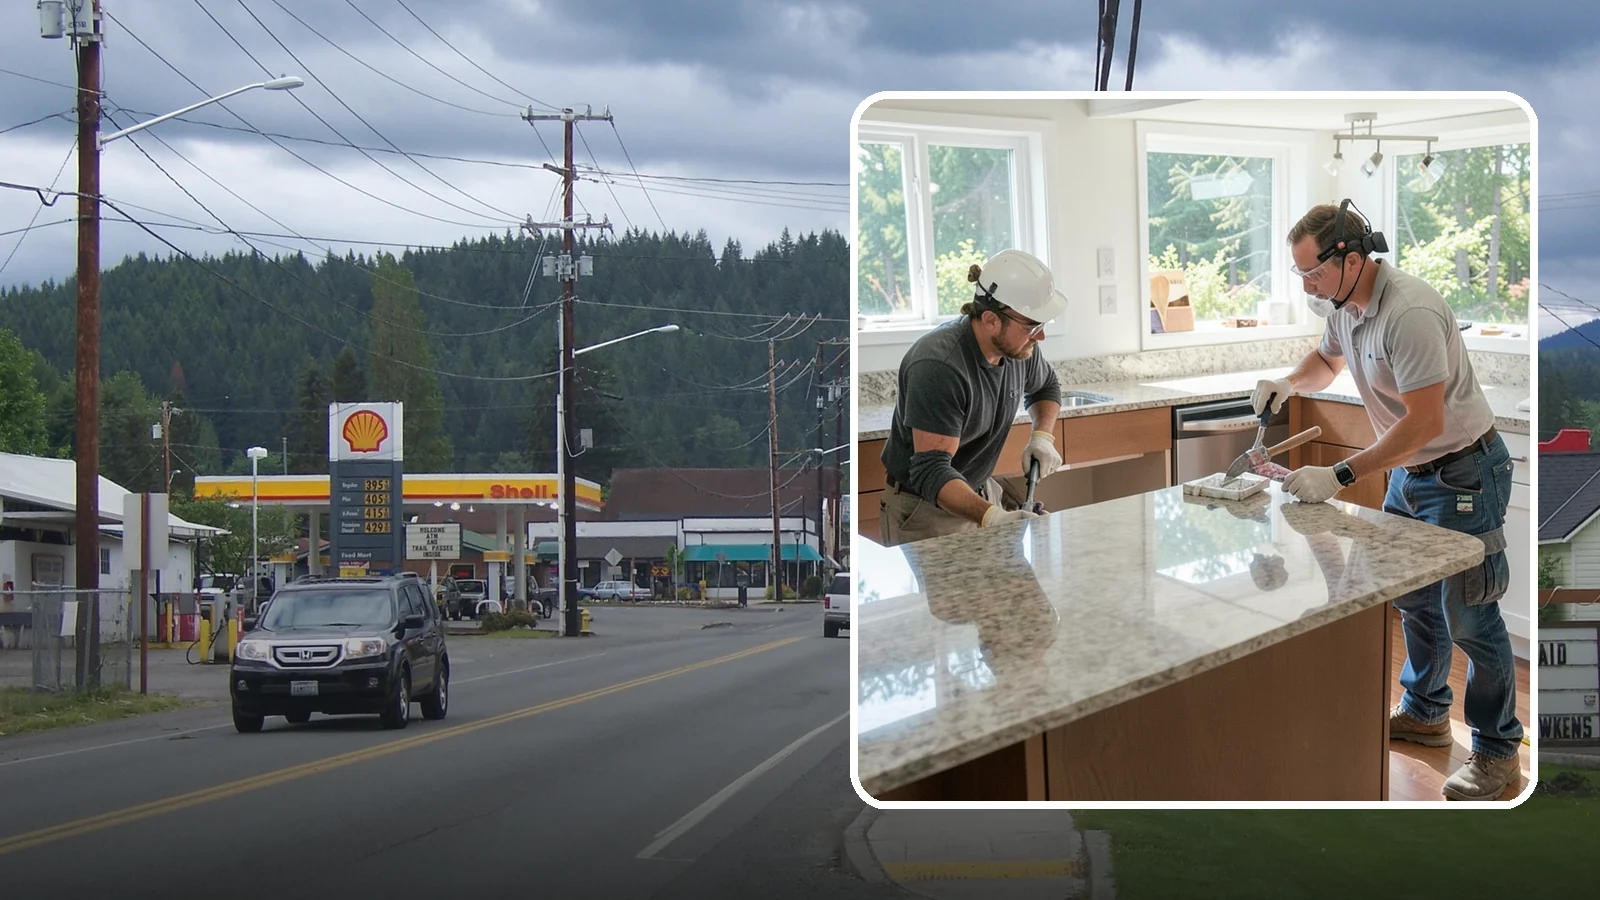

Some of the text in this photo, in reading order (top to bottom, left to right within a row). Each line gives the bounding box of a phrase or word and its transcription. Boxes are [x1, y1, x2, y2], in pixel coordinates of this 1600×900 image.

[365, 480, 383, 490] 395
[490, 484, 547, 499] Shell
[365, 494, 383, 504] 405
[365, 508, 383, 518] 415
[365, 522, 384, 532] 429
[1538, 642, 1567, 666] AID
